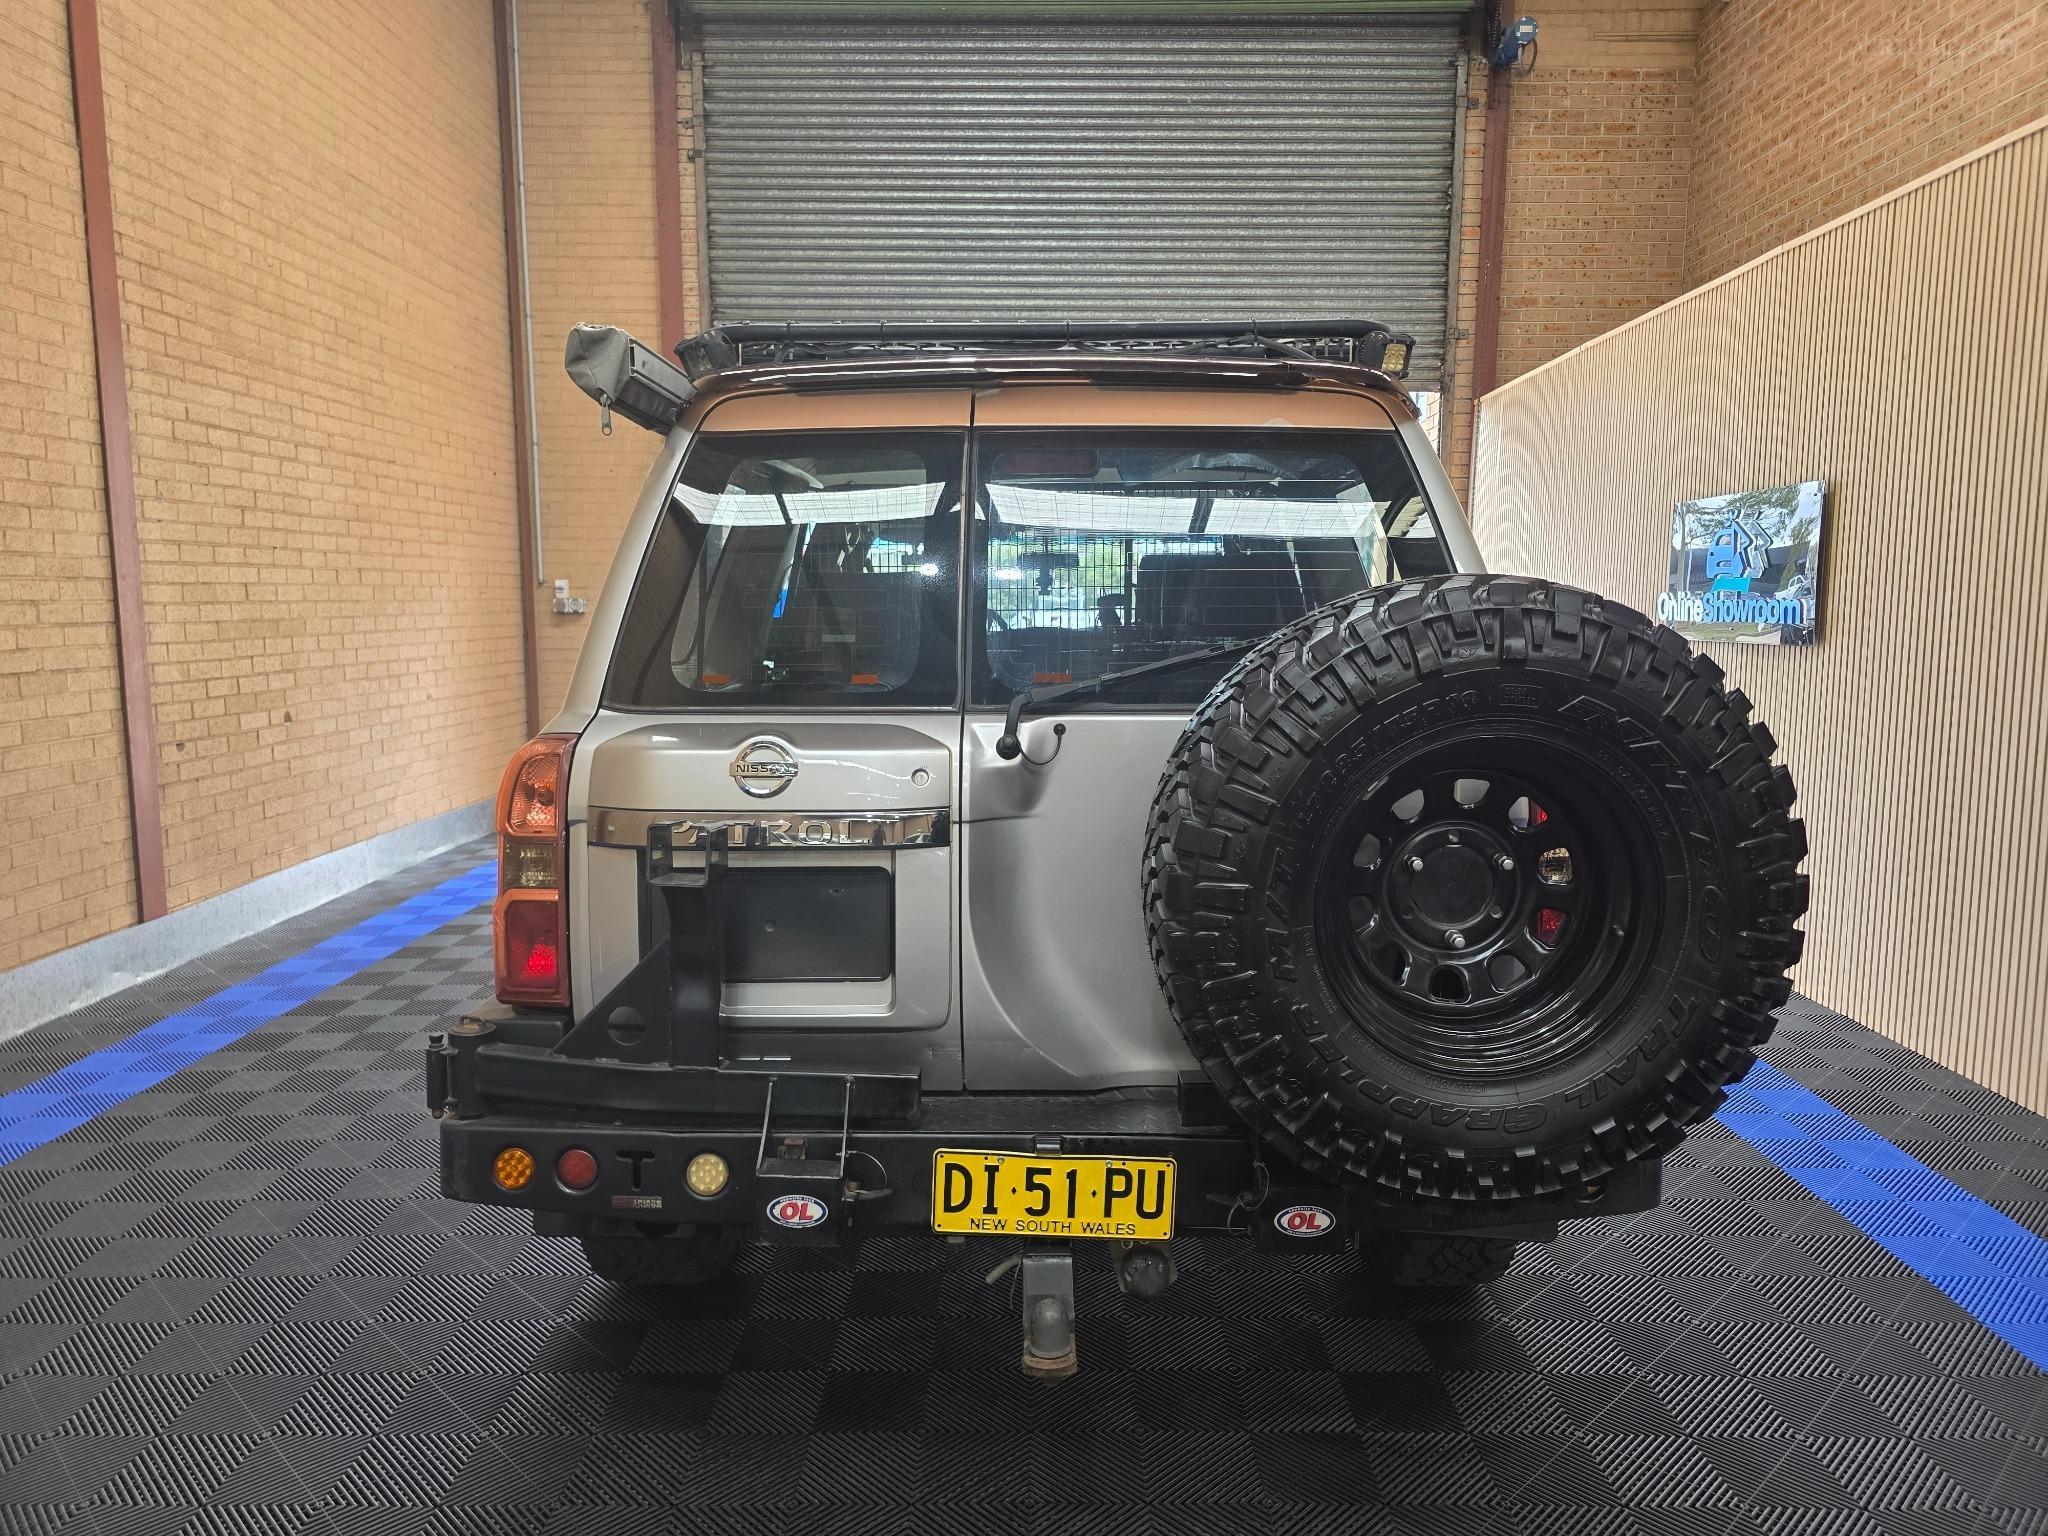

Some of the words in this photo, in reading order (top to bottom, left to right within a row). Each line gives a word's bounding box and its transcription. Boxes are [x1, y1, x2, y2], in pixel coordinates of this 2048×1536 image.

[1657, 592, 1802, 625] OnlineShowroom
[736, 764, 790, 773] NISSAN
[1564, 994, 1699, 1109] TRAIL
[1290, 1003, 1548, 1134] GRAPPLER
[780, 1202, 815, 1221] OL
[1288, 1212, 1322, 1230] OL
[970, 1217, 1008, 1231] NEW
[1015, 1219, 1072, 1234] SOUTH
[1081, 1221, 1137, 1236] WALES
